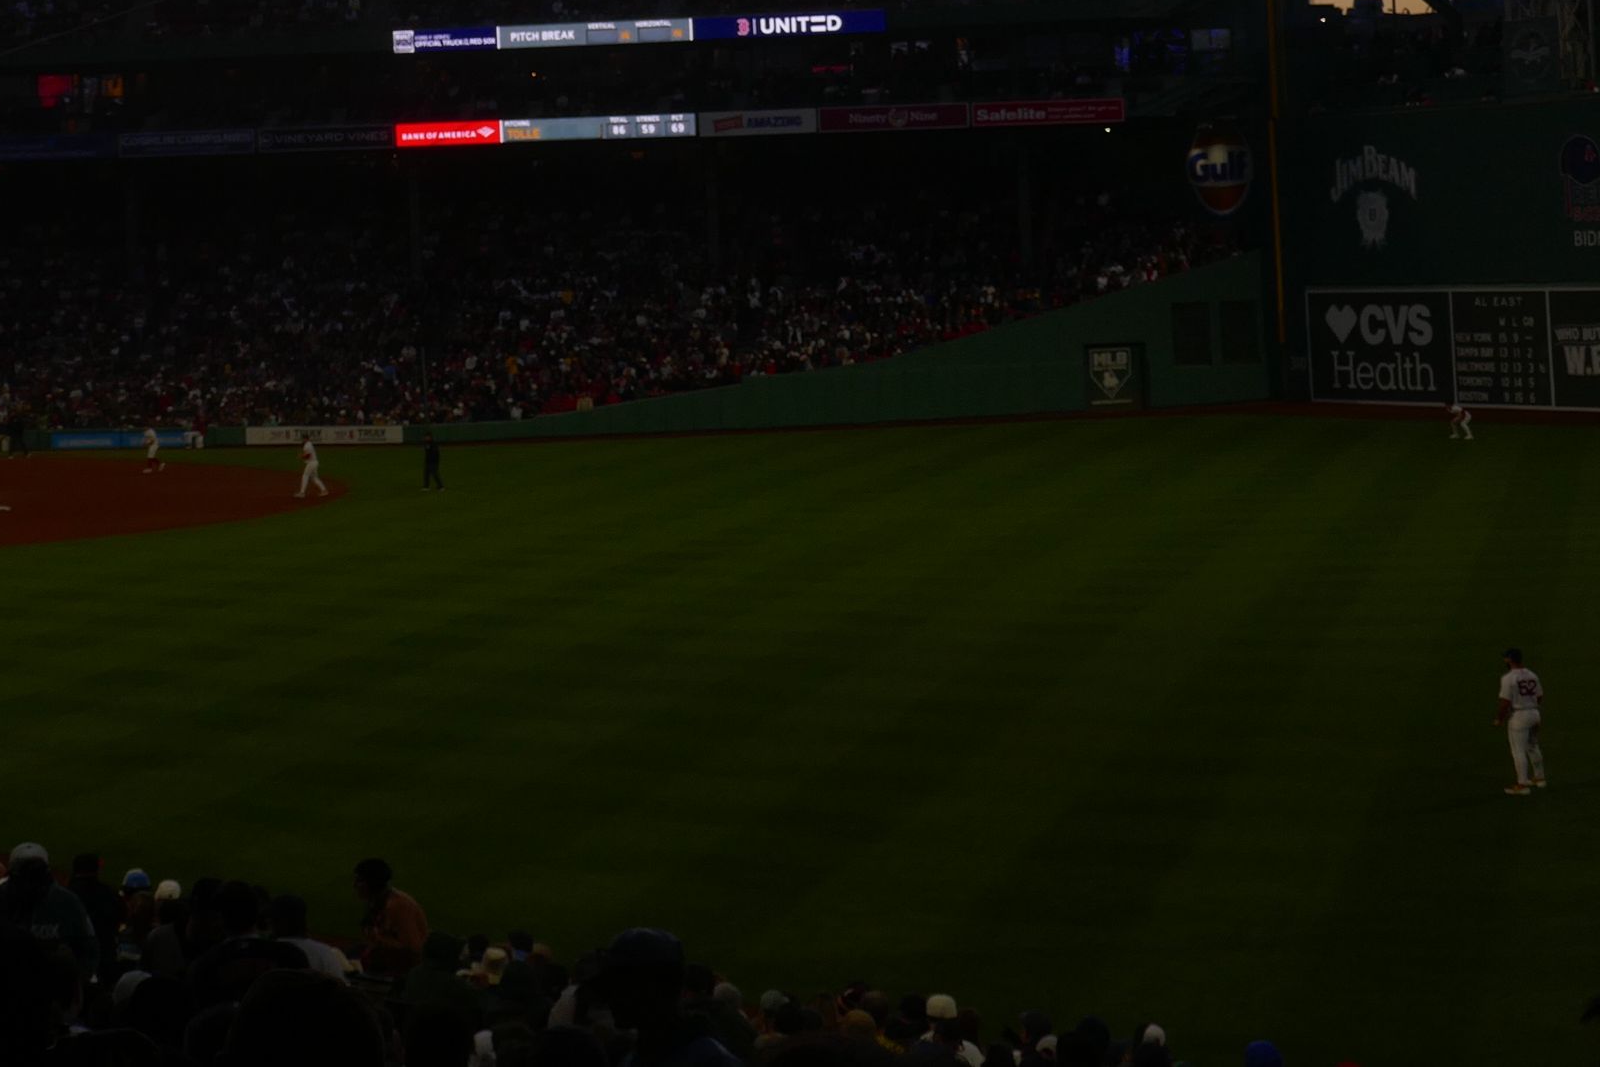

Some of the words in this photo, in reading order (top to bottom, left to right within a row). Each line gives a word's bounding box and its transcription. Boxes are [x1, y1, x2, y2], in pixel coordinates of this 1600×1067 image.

[587, 22, 616, 30] VERTICAL
[634, 19, 671, 28] HORIZONTAL
[759, 15, 843, 34] UNITED
[510, 31, 540, 42] PITCH
[541, 30, 575, 41] BREAK
[848, 112, 888, 125] Ninety
[909, 110, 939, 122] Nine
[976, 108, 1046, 123] Safelite
[641, 124, 656, 134] 59
[671, 122, 685, 133] 69
[274, 133, 345, 144] VINEYARD
[345, 131, 388, 142] VINES
[401, 132, 425, 141] BANK
[425, 131, 437, 140] OF
[437, 130, 477, 140] AMERICA
[1188, 150, 1248, 183] Gulf
[1330, 156, 1363, 203] JIM
[1362, 144, 1418, 201] BEAM
[1574, 230, 1600, 247] BID
[1474, 296, 1487, 307] AL
[1493, 295, 1523, 307] EAST
[1360, 303, 1434, 346] CVS
[1554, 327, 1579, 341] WHO
[1330, 350, 1438, 391] Health
[1458, 376, 1493, 386] TORONTO
